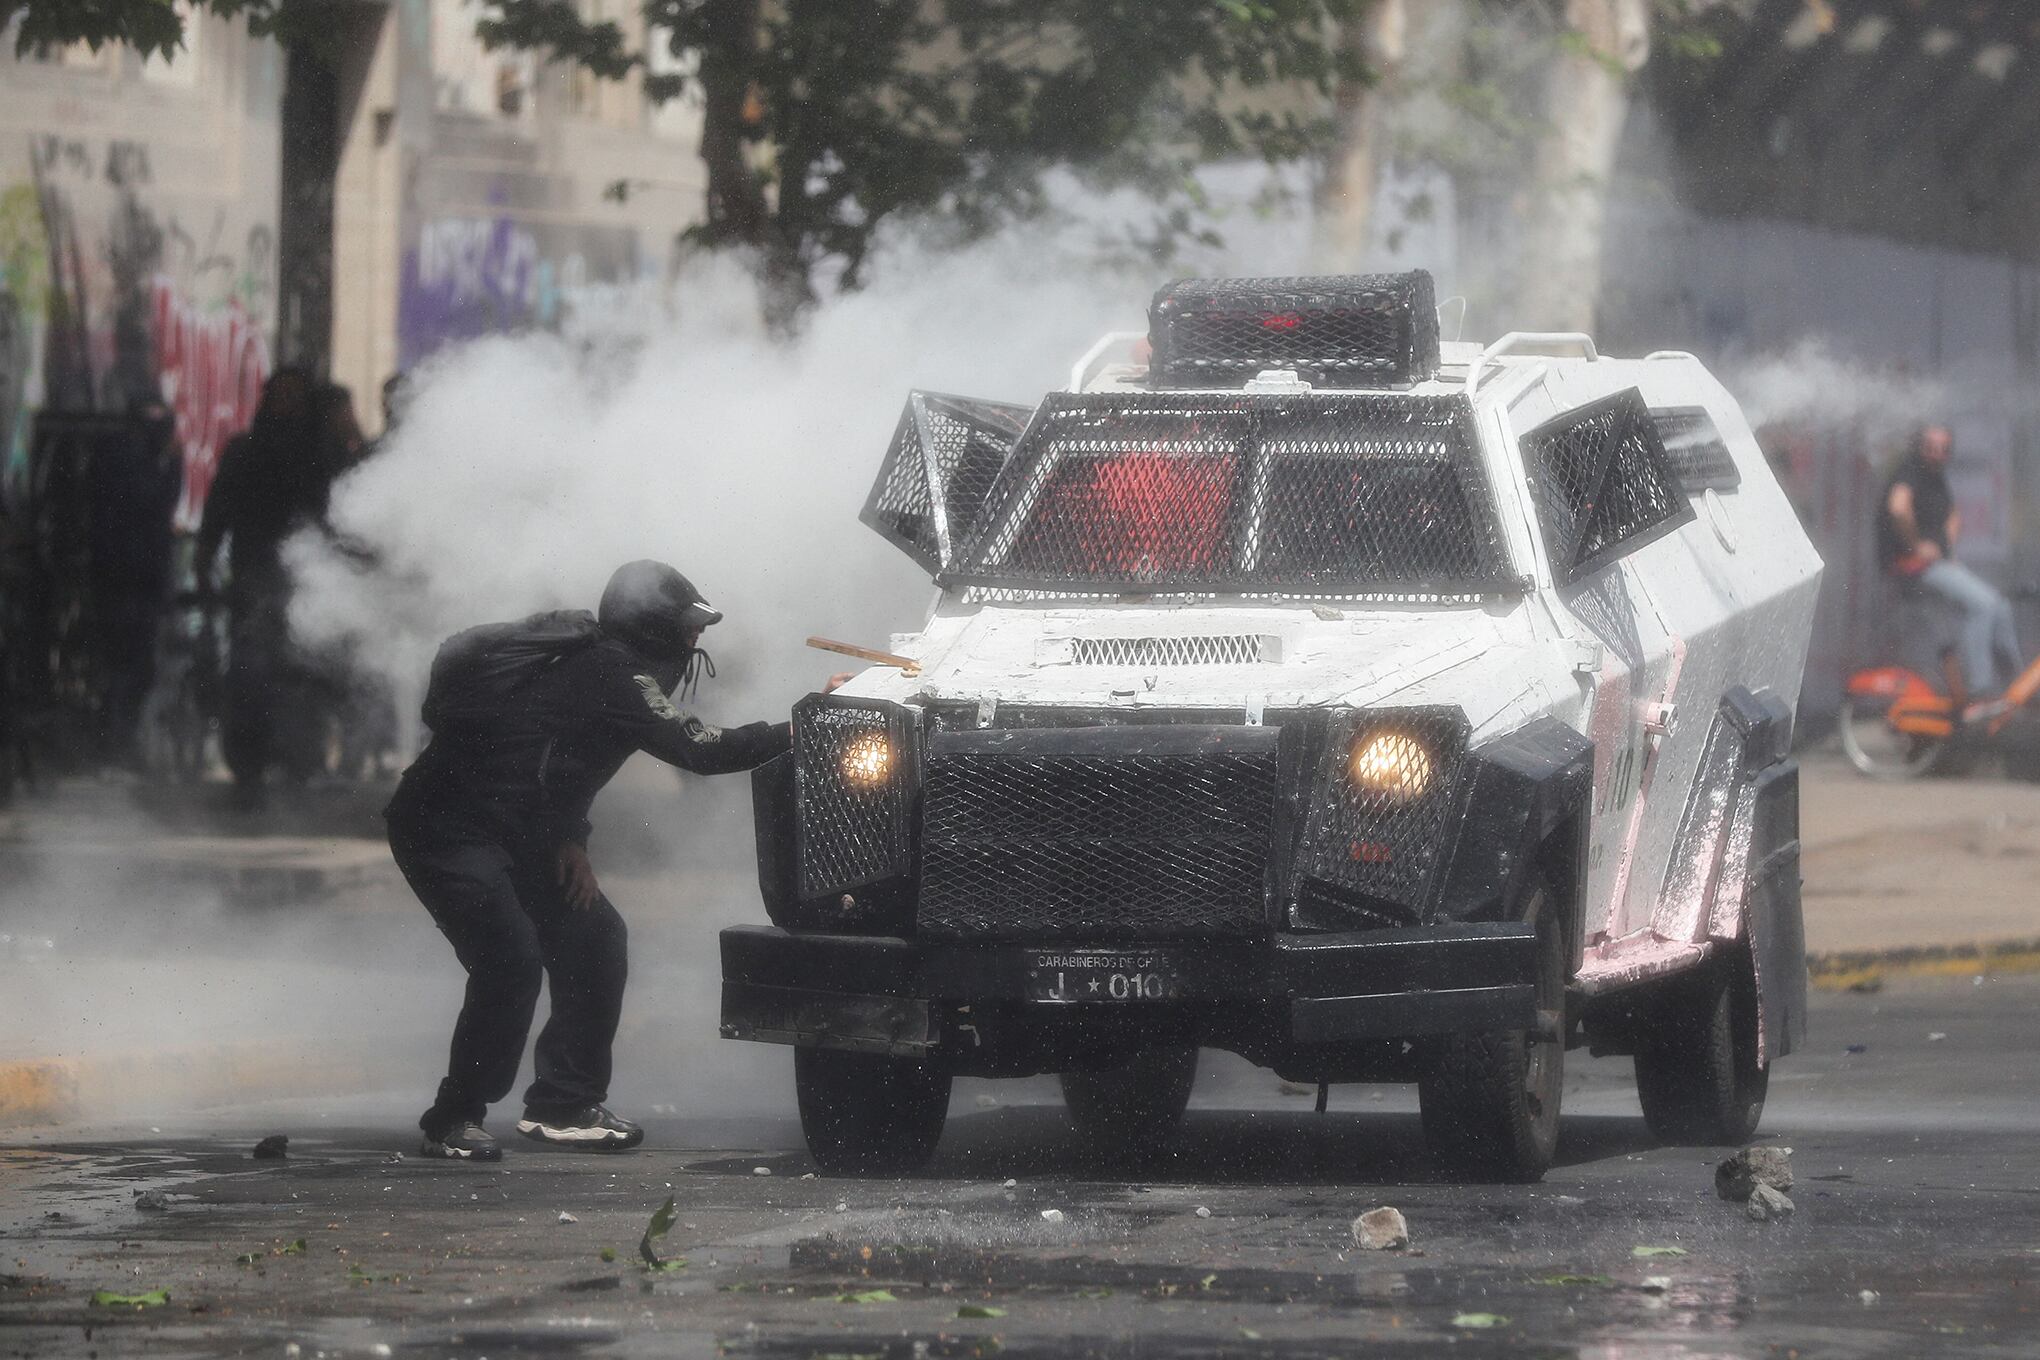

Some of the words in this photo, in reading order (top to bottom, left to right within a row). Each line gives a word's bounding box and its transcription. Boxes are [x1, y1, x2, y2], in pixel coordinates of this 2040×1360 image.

[1038, 955, 1117, 968] CARABINEROS
[1137, 956, 1170, 968] CHLE
[1048, 972, 1065, 1000] J
